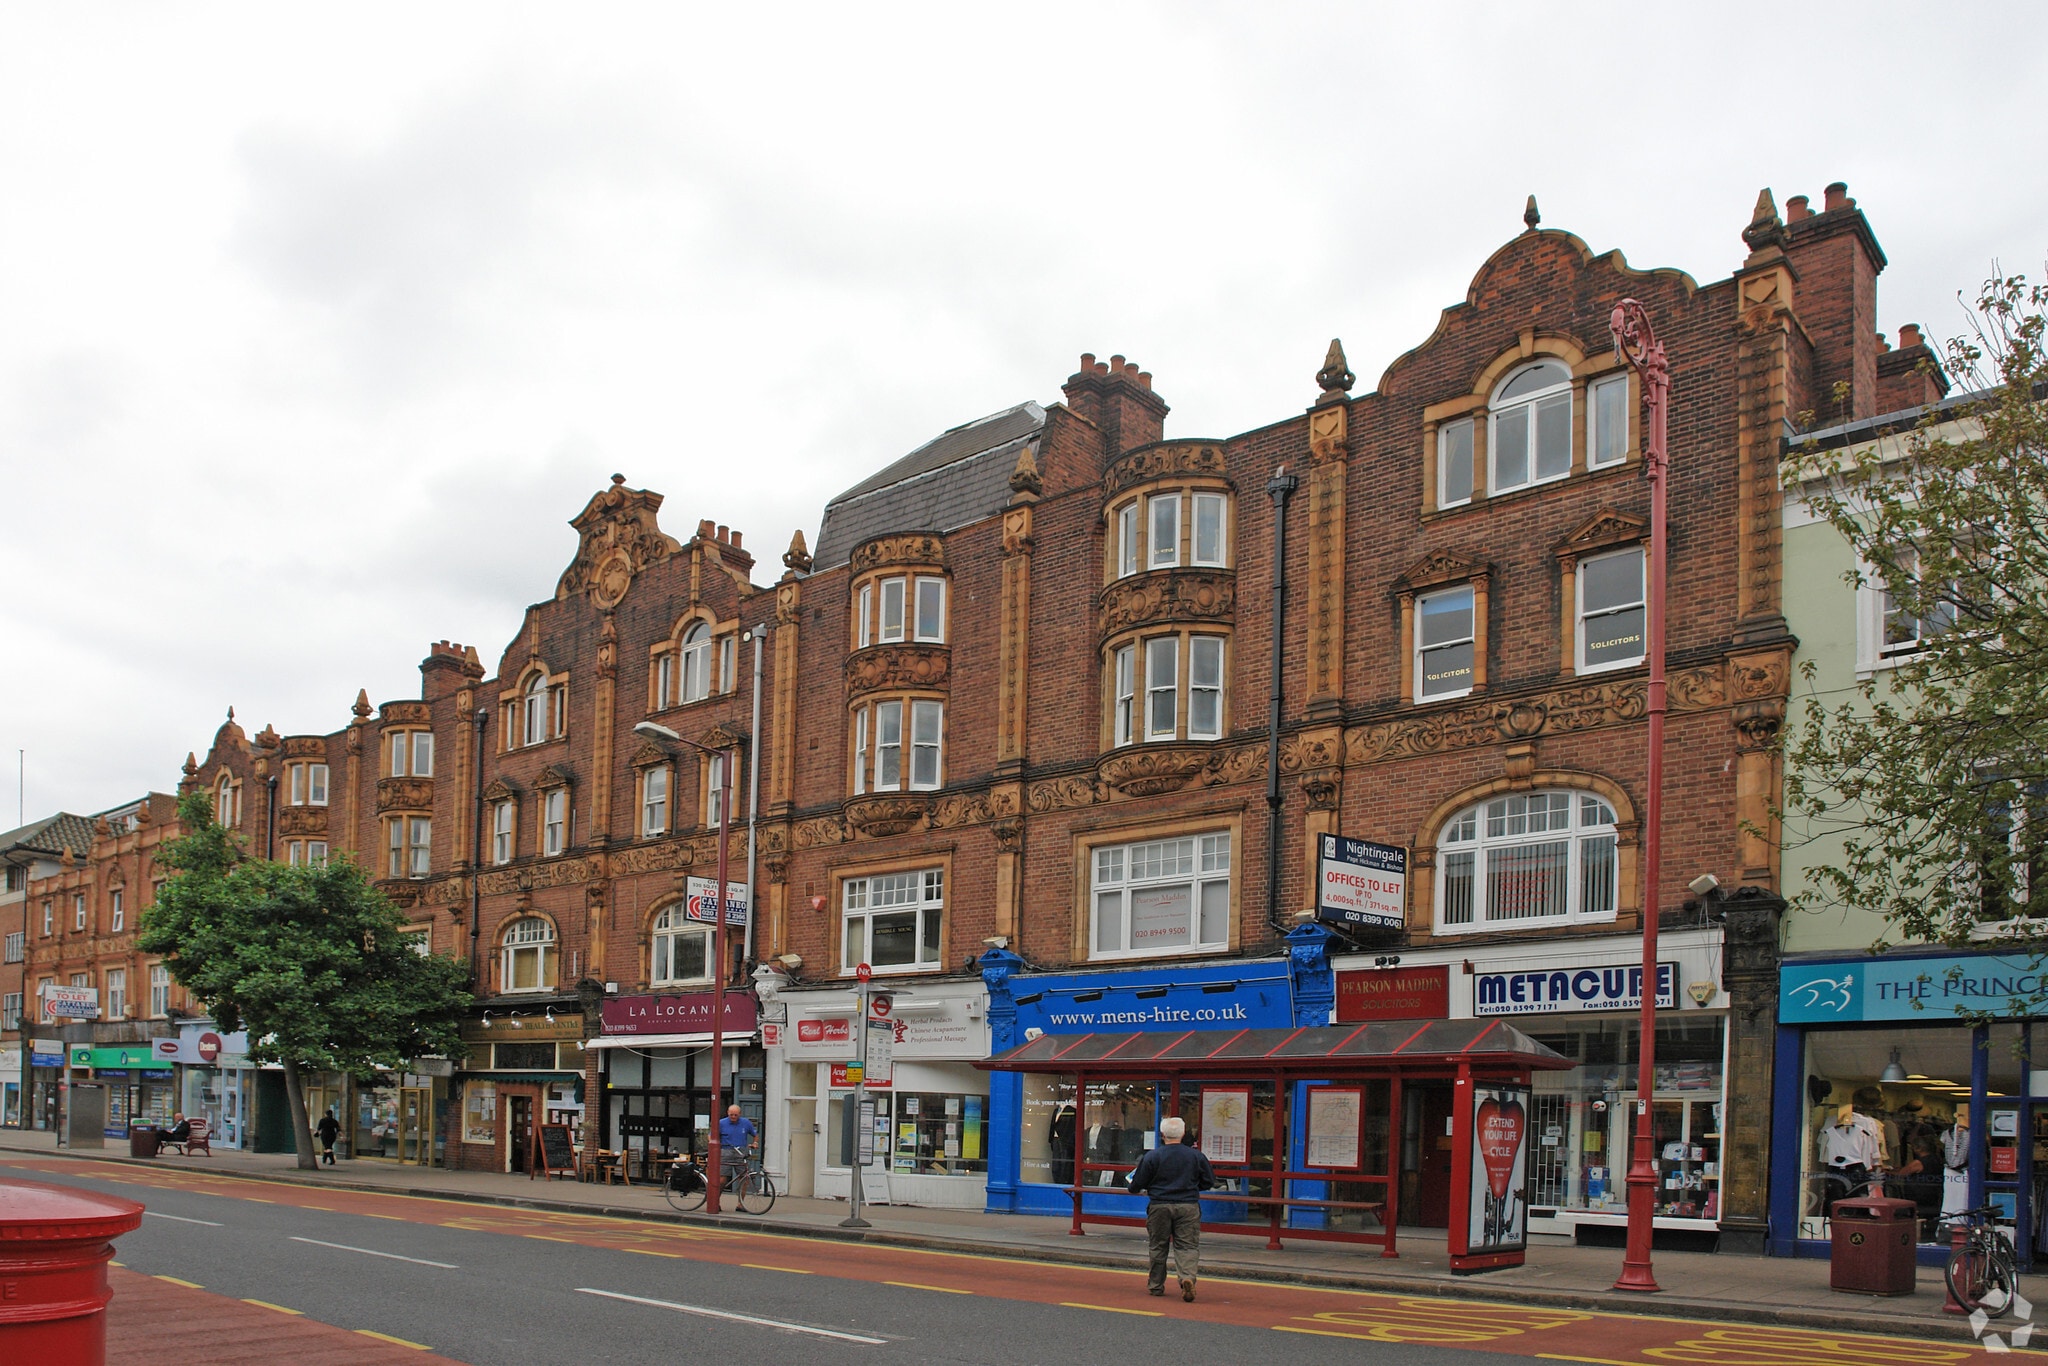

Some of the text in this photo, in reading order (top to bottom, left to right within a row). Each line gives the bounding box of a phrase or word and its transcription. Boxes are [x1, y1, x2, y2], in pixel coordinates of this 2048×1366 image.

[1591, 635, 1640, 649] SOLICITORS
[1427, 667, 1471, 681] SOLICITORS
[1346, 841, 1404, 862] Nightingale
[1326, 871, 1400, 894] OFFICES TO LET
[703, 889, 716, 897] TO
[1355, 889, 1372, 899] UP TO
[702, 897, 746, 909] CATANEO
[1345, 911, 1402, 928] 020 8399 0061
[1135, 930, 1148, 938] 020
[1168, 927, 1186, 935] 9500
[858, 968, 870, 977] NK
[1342, 977, 1441, 994] PEARSON MADDIN
[1876, 981, 1932, 1000] THE
[656, 1003, 732, 1016] LOCANA
[1362, 998, 1421, 1010] SOLICITORS
[1513, 1004, 1534, 1012] 8399
[1536, 1003, 1558, 1011] 7171
[1050, 1003, 1247, 1024] www.mens-hire.co.uk
[800, 1024, 849, 1035] Real Herbs
[932, 1026, 967, 1034] Acupuncture
[910, 1036, 943, 1045] Professional
[1488, 1117, 1515, 1128] EXTEND
[1484, 1130, 1517, 1141] YOUR LIFE
[1288, 1300, 1593, 1343] STOP
